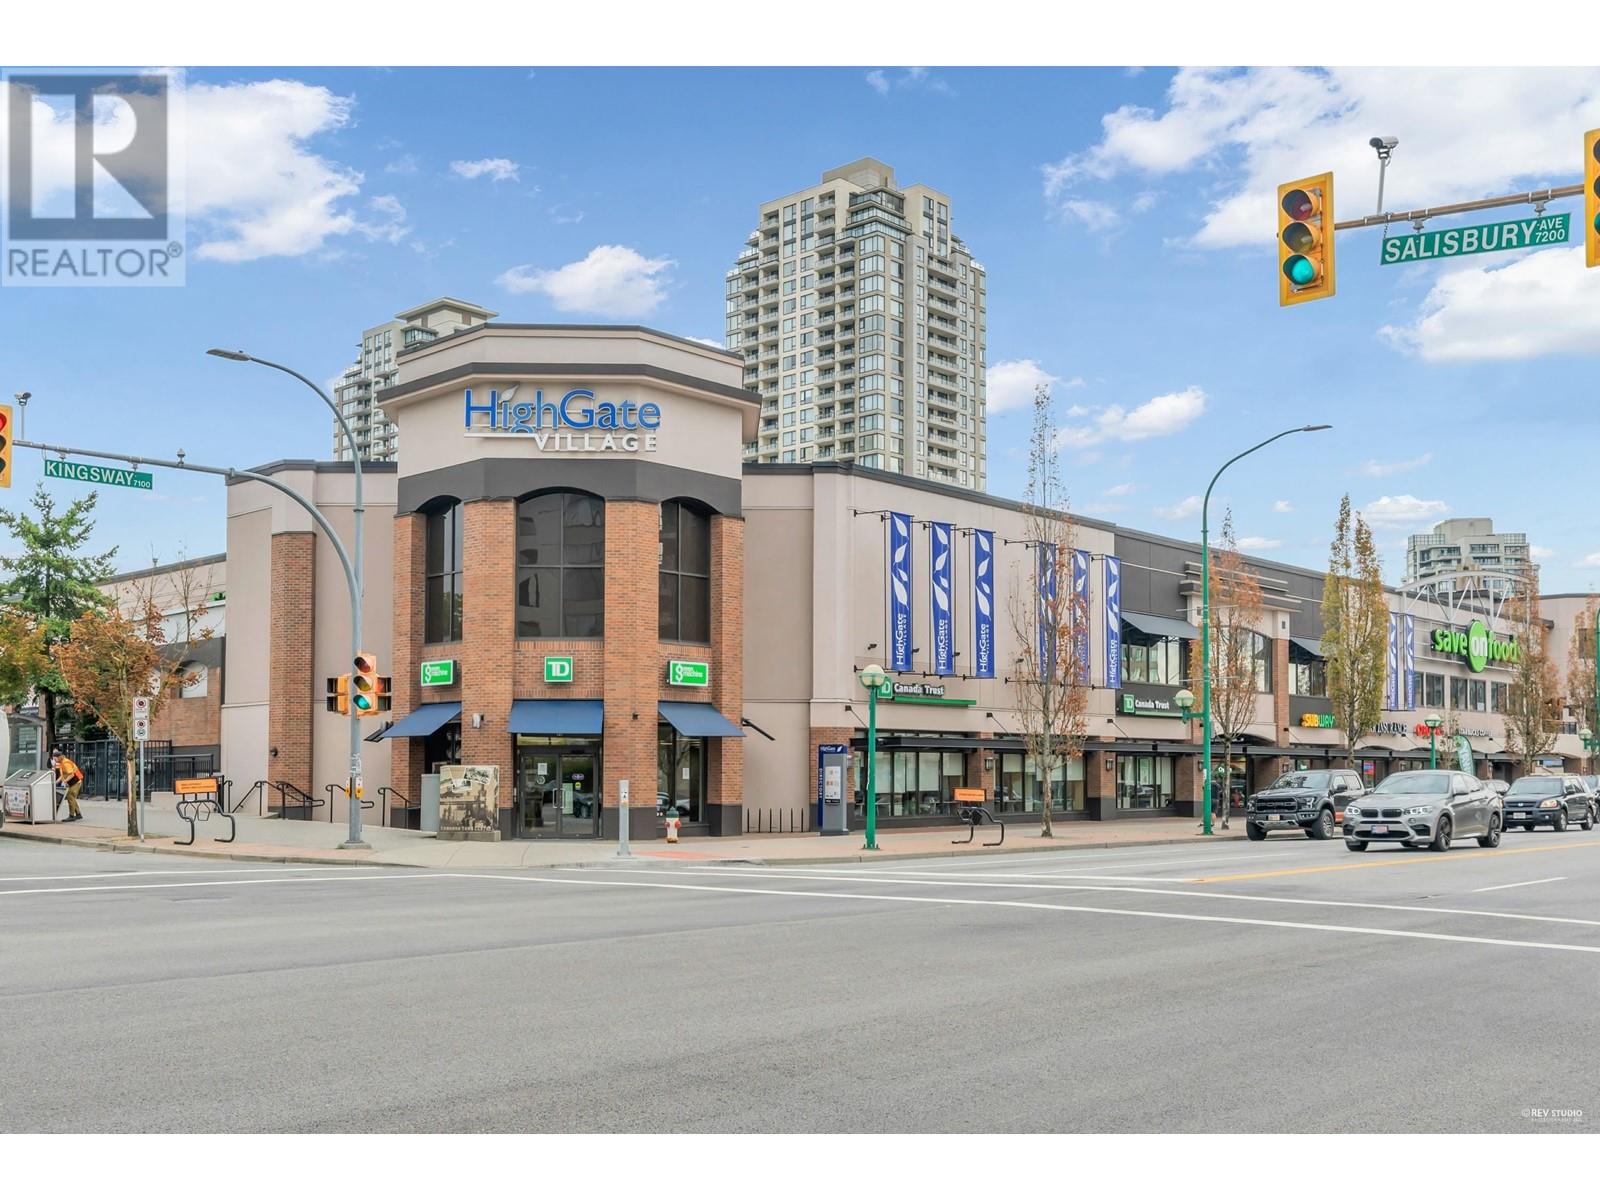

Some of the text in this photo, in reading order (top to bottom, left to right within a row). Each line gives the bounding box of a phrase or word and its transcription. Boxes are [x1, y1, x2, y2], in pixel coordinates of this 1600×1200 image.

[1384, 216, 1563, 263] SALISBURY AVE
[1535, 228, 1566, 244] 7200
[464, 386, 662, 434] HighGate
[534, 433, 657, 451] VILLAGE
[46, 460, 151, 489] KINGSWAY 7100
[896, 613, 905, 666] HighGate
[937, 619, 946, 670] HighGate
[979, 624, 987, 673] HighGate
[1434, 629, 1467, 656] save
[1472, 636, 1488, 657] on
[547, 661, 570, 677] TD
[894, 683, 923, 693] Canada
[925, 685, 944, 695] Trust
[1135, 699, 1155, 709] Canada
[1155, 700, 1170, 710] Trust
[1302, 714, 1335, 729] SUBWAY
